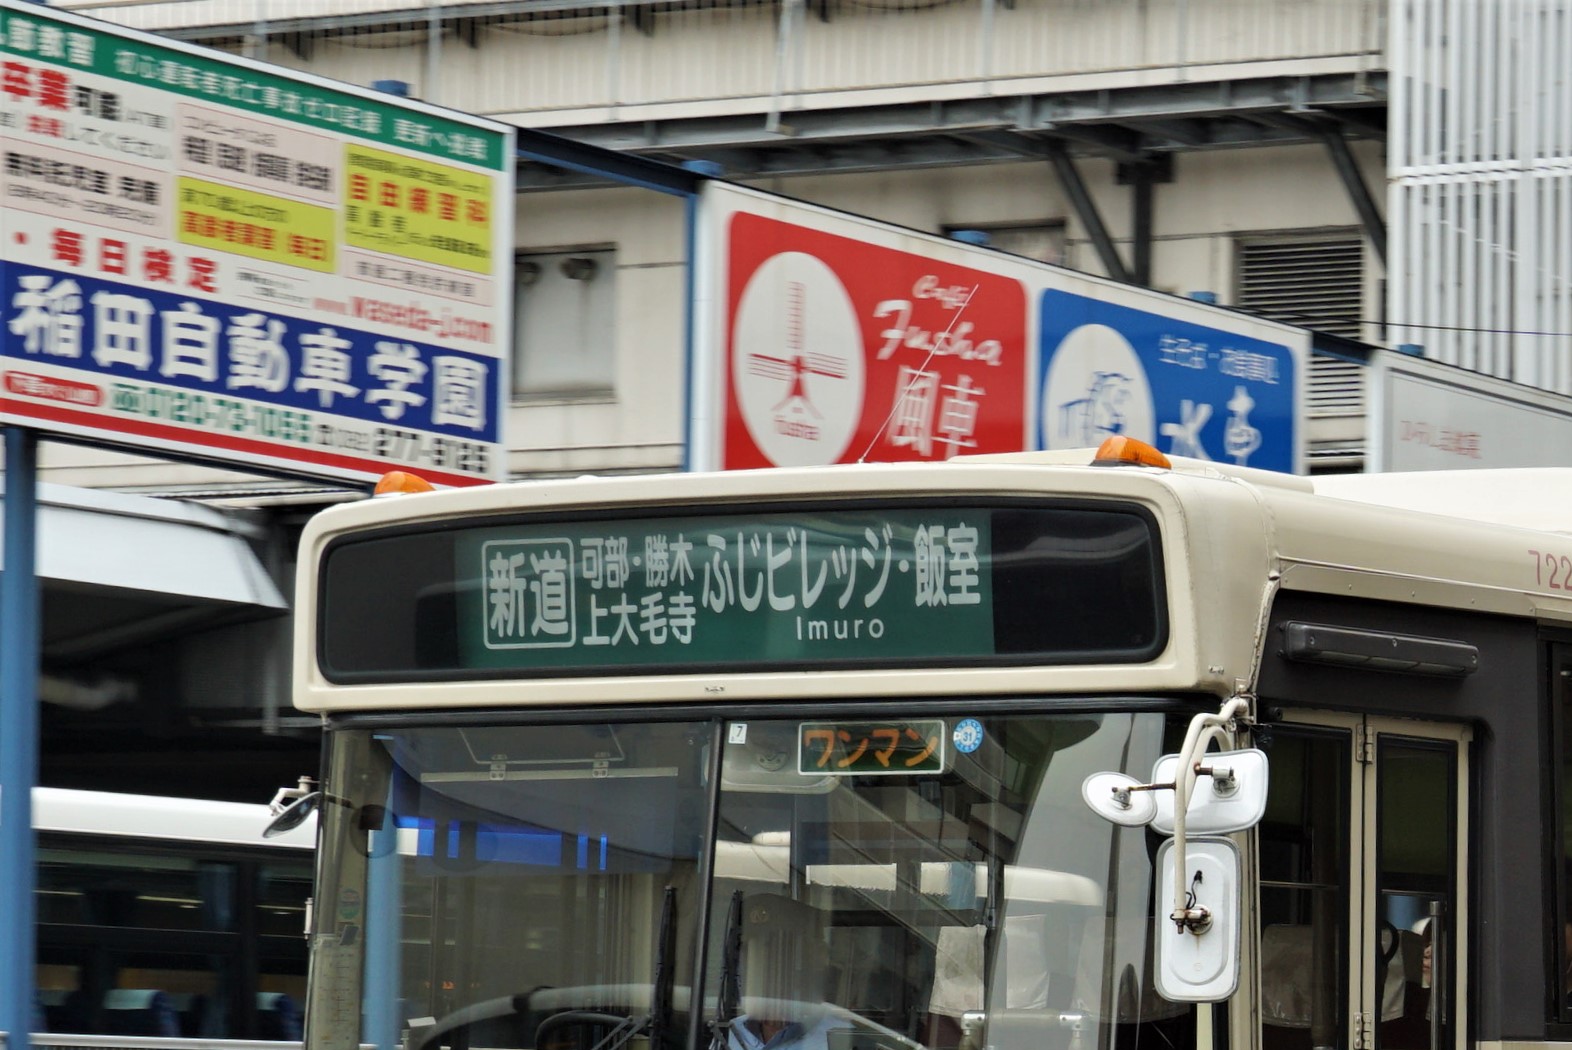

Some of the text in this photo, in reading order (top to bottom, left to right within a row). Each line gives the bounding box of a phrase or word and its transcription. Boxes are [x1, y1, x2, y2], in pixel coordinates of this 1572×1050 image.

[580, 537, 694, 590] 可部・勝木
[700, 521, 983, 615] ふじビレッジ・飯室
[487, 552, 572, 638] 新道
[581, 594, 697, 648] 上大毛寺
[796, 614, 886, 641] Imuro
[804, 729, 938, 768] ワンマン
